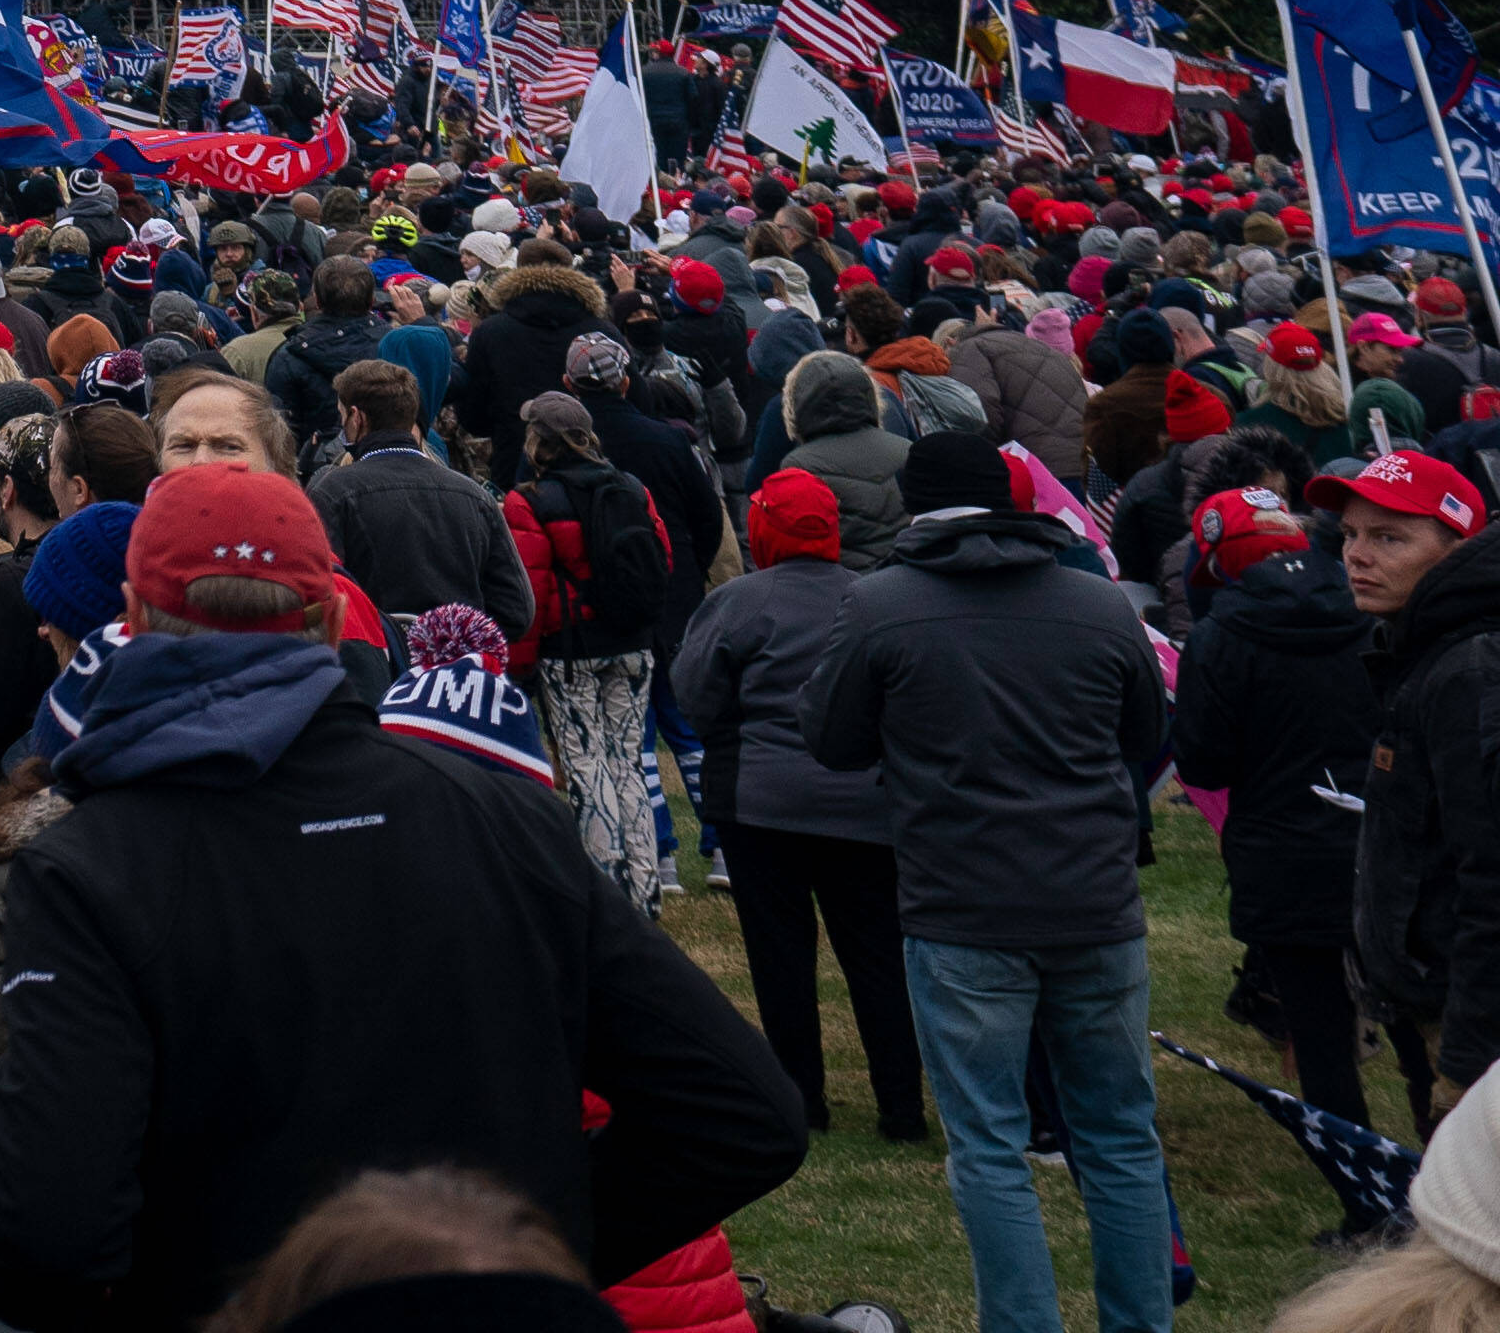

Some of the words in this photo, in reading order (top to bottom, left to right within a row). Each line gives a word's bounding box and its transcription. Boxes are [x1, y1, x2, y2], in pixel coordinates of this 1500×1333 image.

[791, 64, 806, 79] AN
[811, 78, 842, 112] APPEAL
[842, 109, 855, 124] TO
[906, 93, 963, 112] -2020-
[1358, 191, 1442, 216] KEEP
